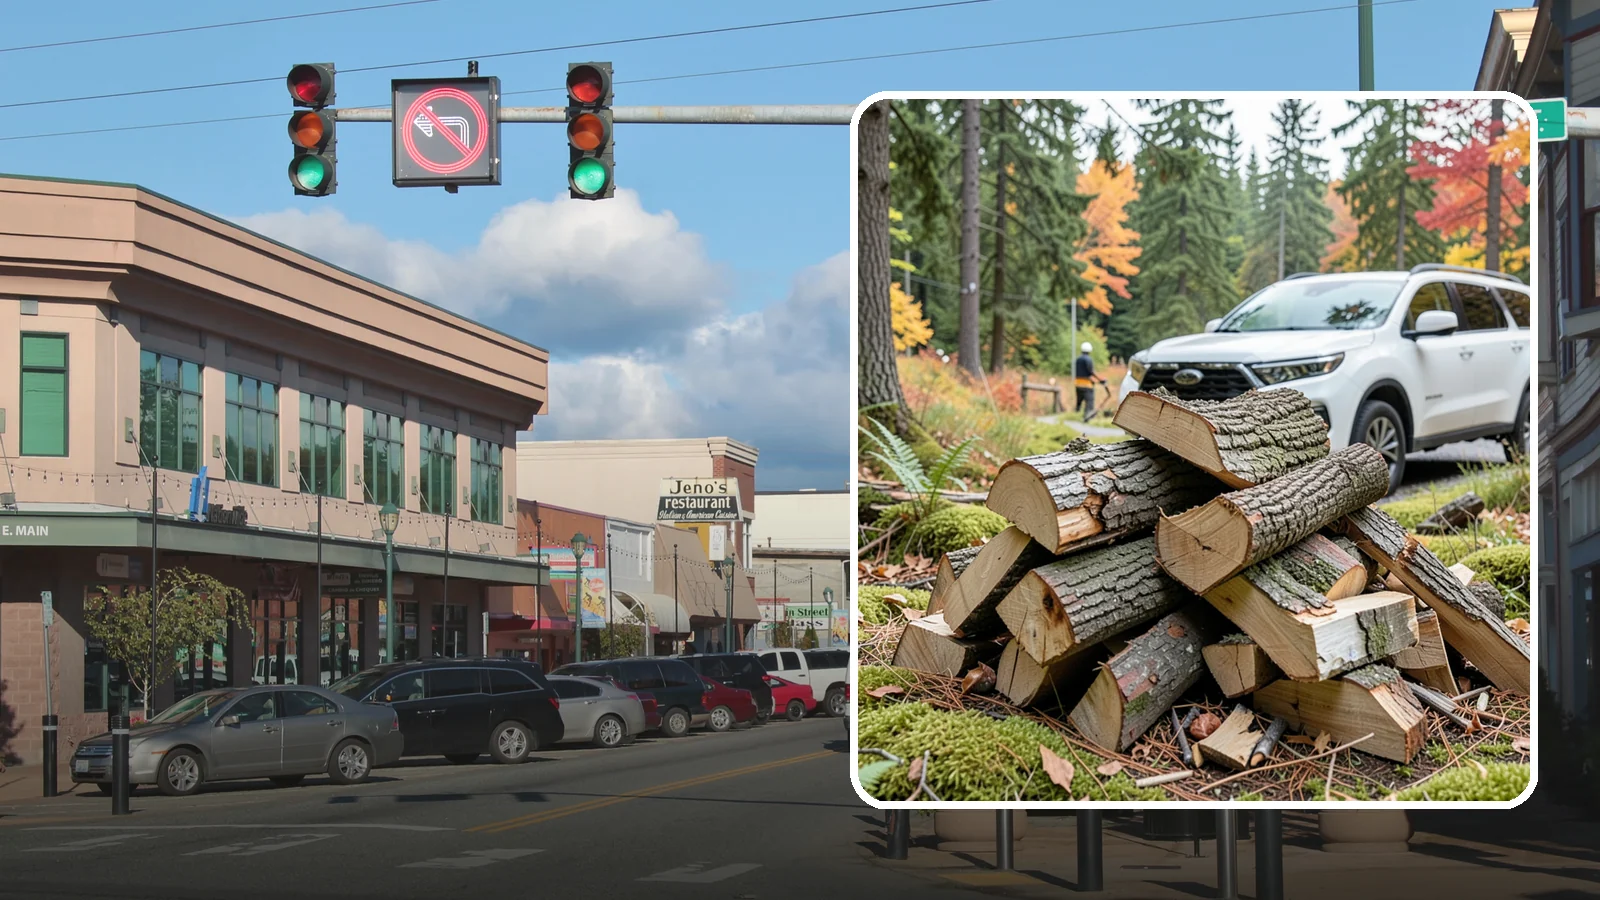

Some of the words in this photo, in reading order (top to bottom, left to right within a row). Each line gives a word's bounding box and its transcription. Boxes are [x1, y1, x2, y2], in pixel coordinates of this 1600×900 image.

[669, 480, 727, 494] Jeno's
[665, 496, 731, 509] restaurant
[658, 509, 681, 520] Italian
[686, 509, 715, 519] American
[715, 509, 738, 519] Cuisine
[2, 525, 13, 536] E.
[15, 525, 49, 536] MAIN
[797, 607, 828, 616] Street
[790, 619, 823, 627] lass
